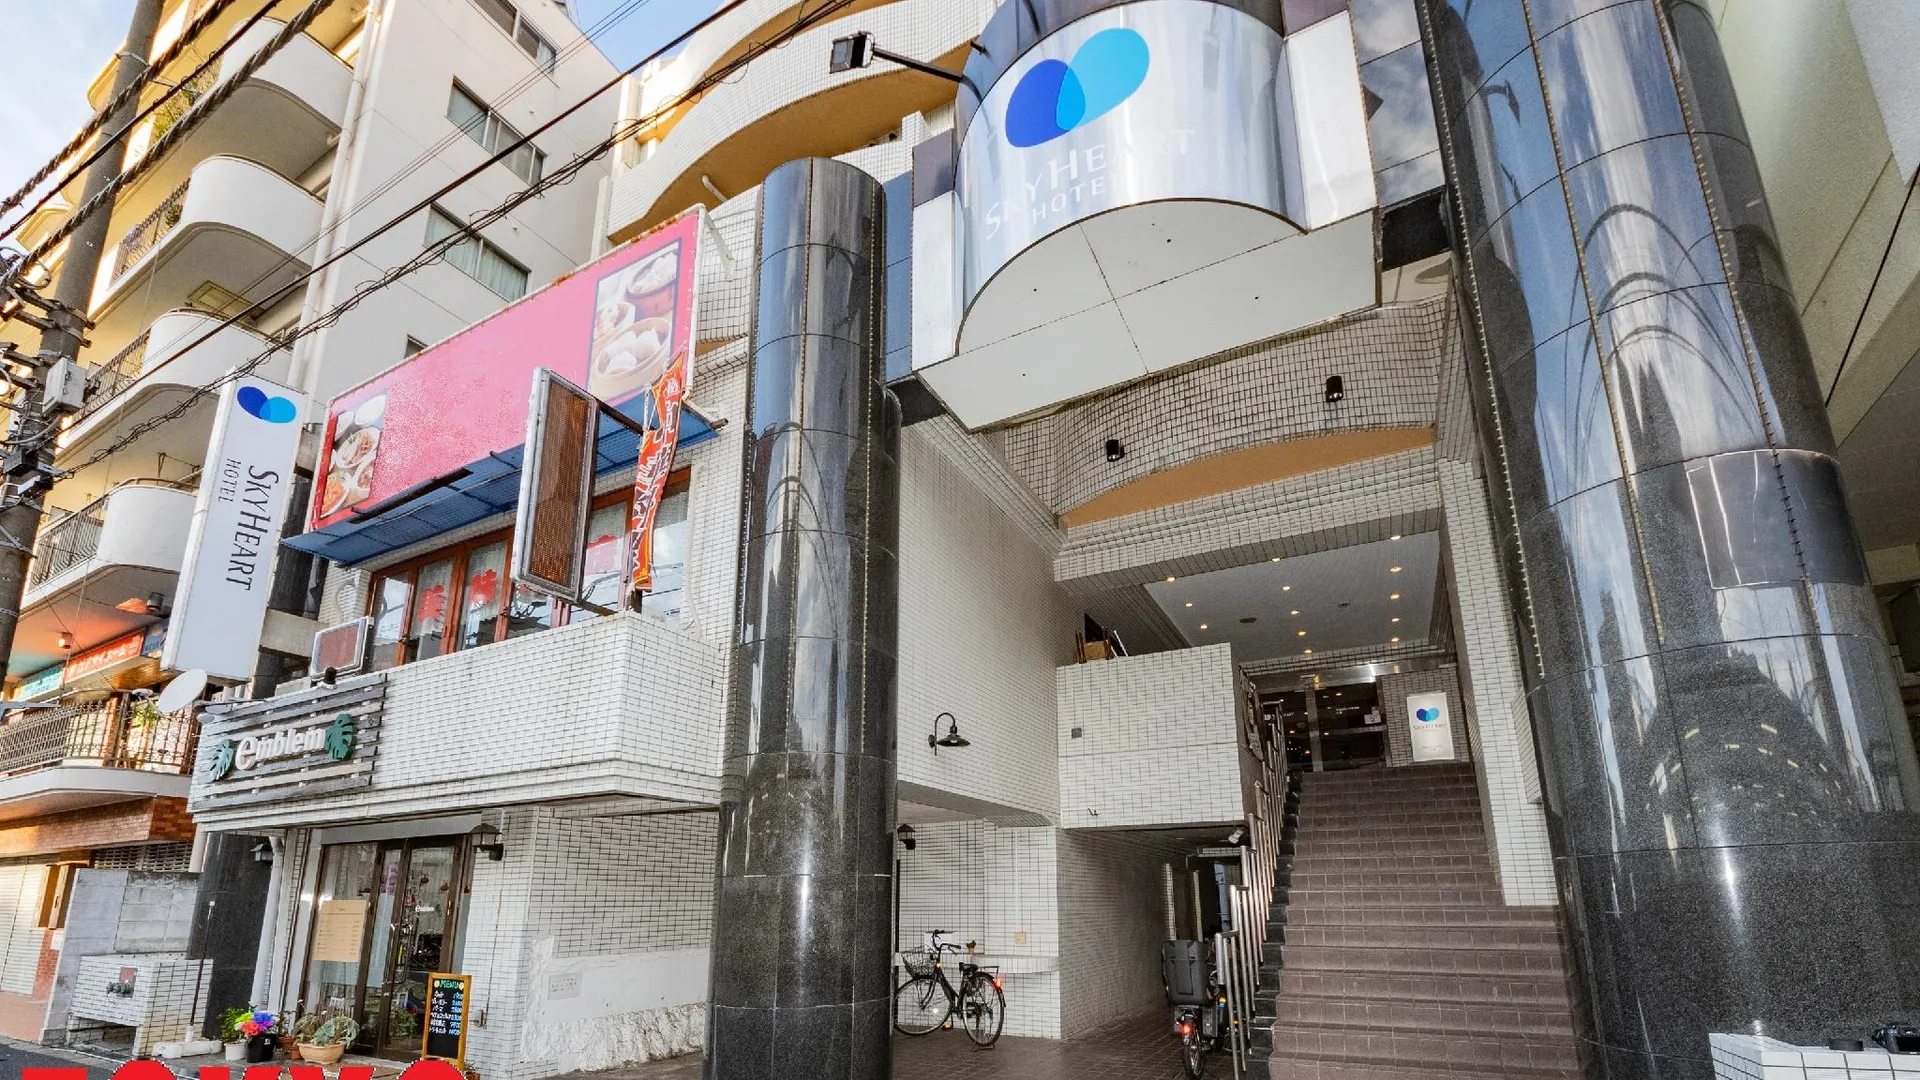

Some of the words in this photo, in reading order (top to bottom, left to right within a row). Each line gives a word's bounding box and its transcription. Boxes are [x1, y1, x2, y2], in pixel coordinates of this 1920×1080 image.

[217, 458, 242, 503] HOTEL
[225, 465, 280, 591] SKYHEART
[235, 727, 327, 771] emblem
[440, 980, 459, 989] MENU
